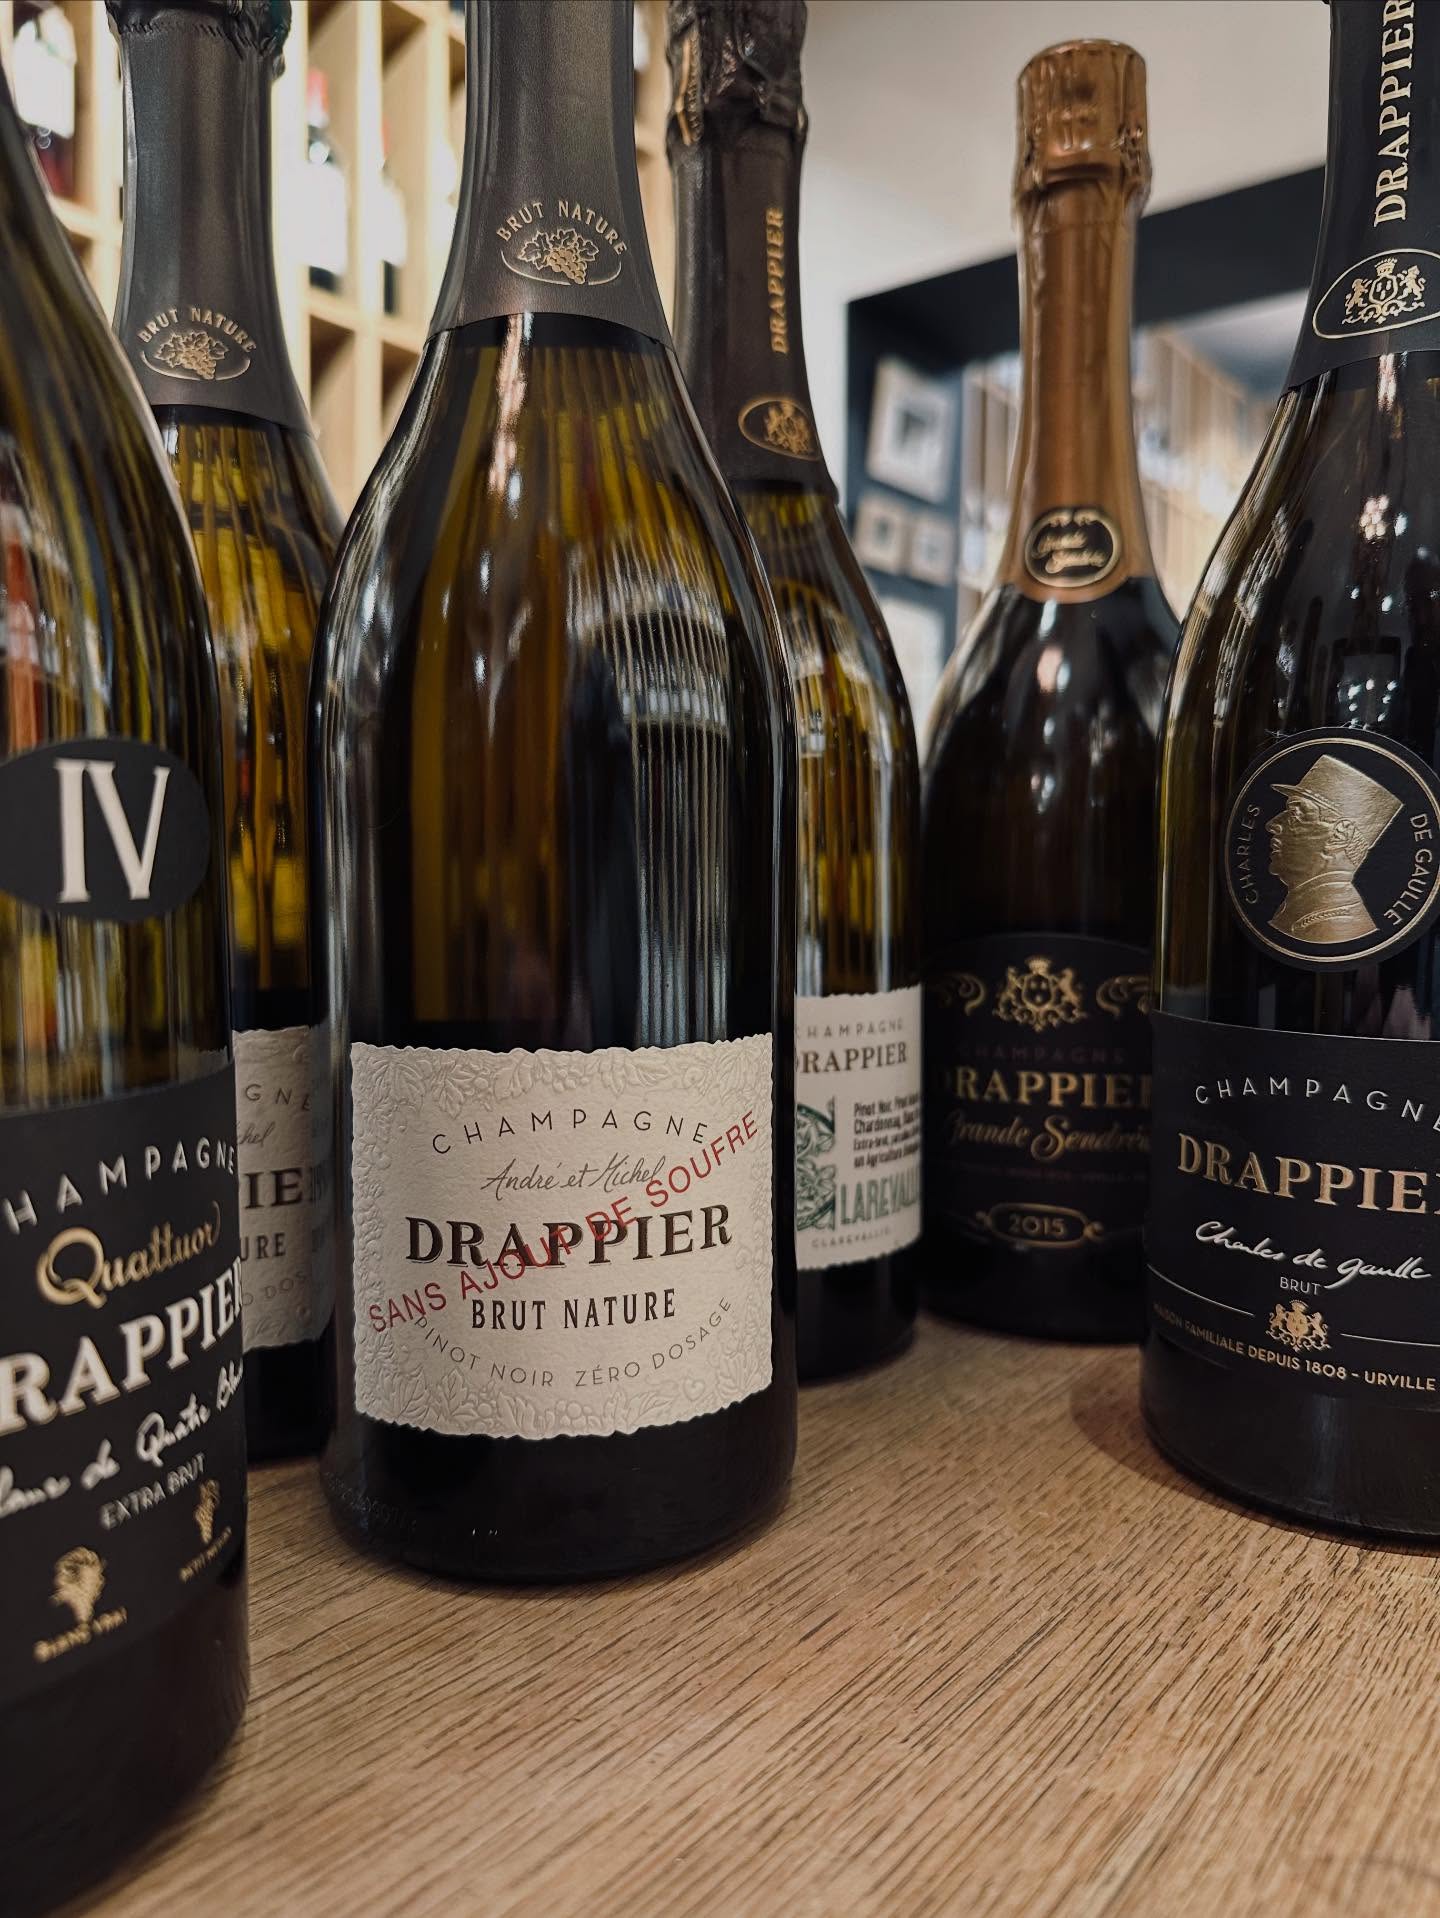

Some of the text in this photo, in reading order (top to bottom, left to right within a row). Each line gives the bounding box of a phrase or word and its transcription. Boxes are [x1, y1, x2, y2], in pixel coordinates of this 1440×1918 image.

[1373, 0, 1415, 228] DRAPPIER
[497, 200, 628, 255] BRUT NATURE
[766, 207, 789, 355] DRAPPIER
[138, 306, 257, 353] BRUT NATURE
[54, 758, 171, 903] IV
[1236, 804, 1260, 904] CHARLES
[1384, 813, 1433, 926] DE GAULLE
[431, 1108, 709, 1155] CHAMPAGNE
[480, 1153, 667, 1201] André et Michel
[1177, 1132, 1440, 1215] DRAPPIE
[36, 1201, 221, 1309] Quattuor
[368, 1110, 760, 1333] SANS AJOUT DE SOUFRE
[405, 1204, 733, 1270] DRAPPIER
[1008, 1214, 1068, 1239] 2015
[1195, 1221, 1286, 1261] Charles
[1292, 1248, 1328, 1268] de
[472, 1287, 677, 1330] BRUT NATURE
[1280, 1277, 1320, 1295] BRUT
[413, 1296, 732, 1388] PINOT NOIR ZÉRO DOSAGE
[1185, 1319, 1245, 1355] FAMILIALE
[1248, 1345, 1301, 1370] DEPUIS
[1306, 1359, 1347, 1380] 1808
[1364, 1370, 1437, 1391] URVILLE
